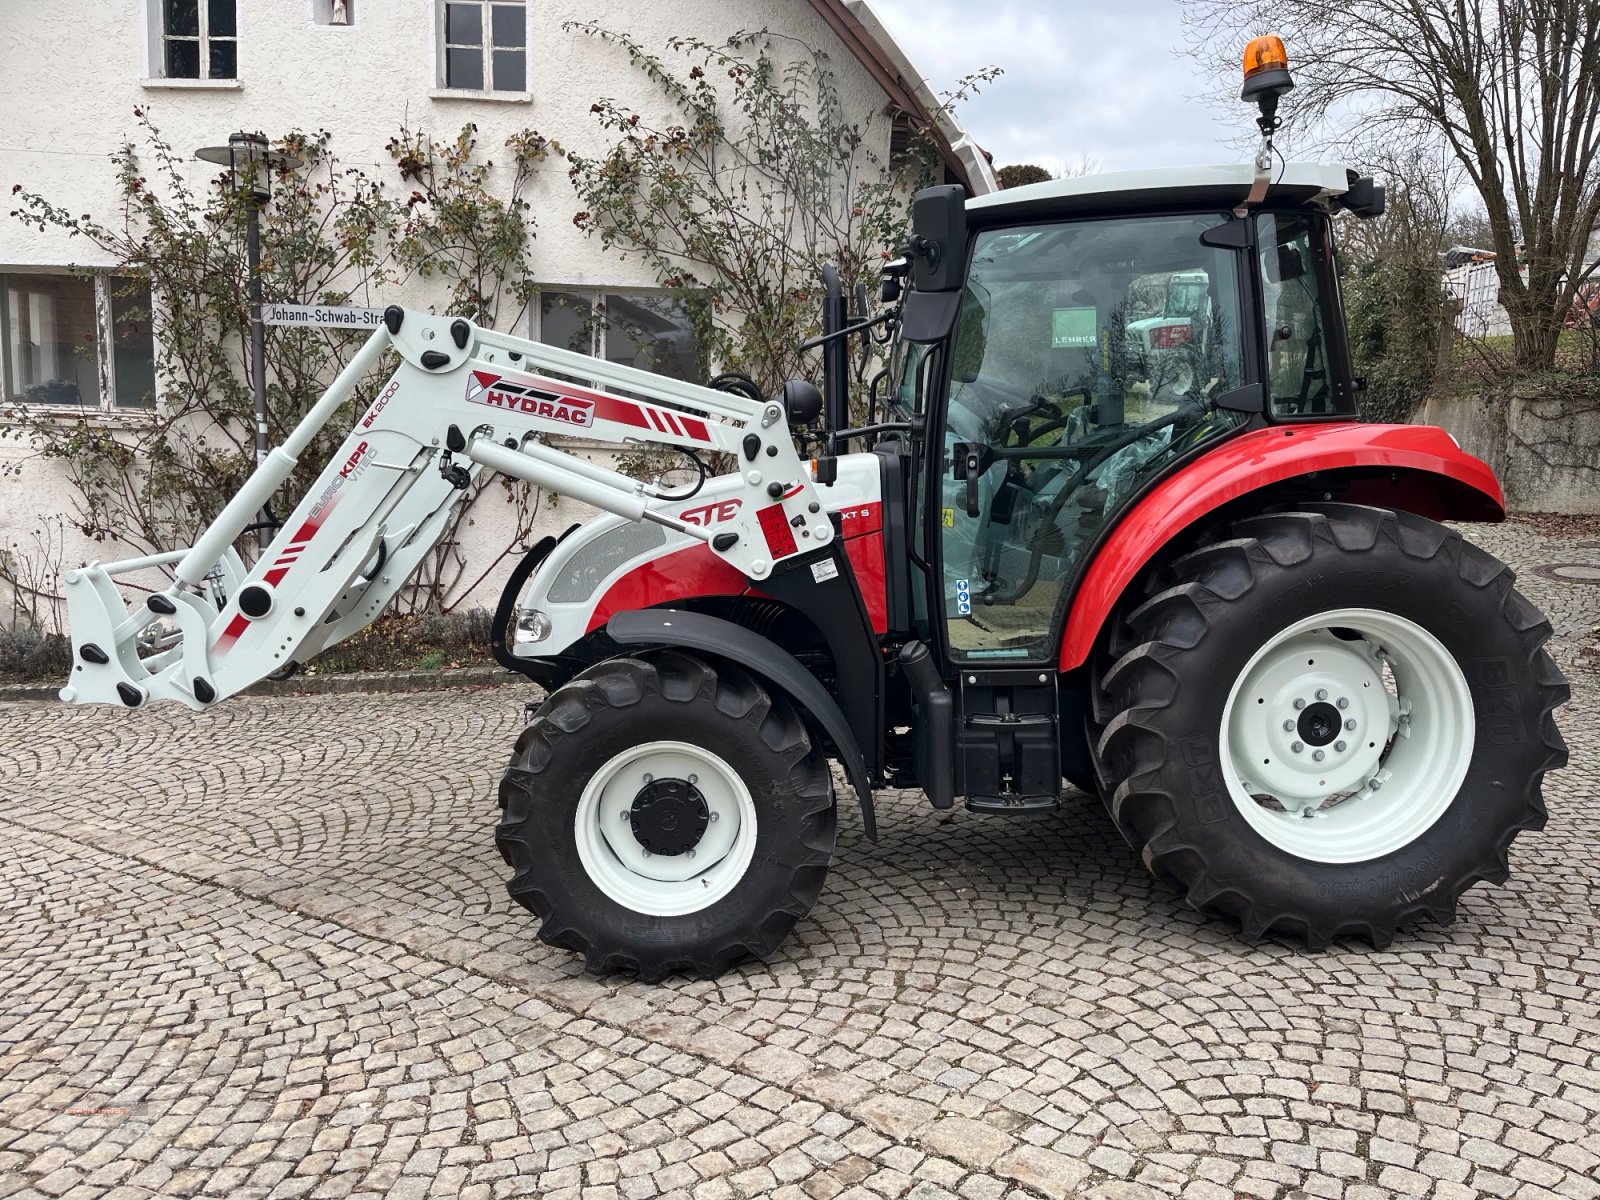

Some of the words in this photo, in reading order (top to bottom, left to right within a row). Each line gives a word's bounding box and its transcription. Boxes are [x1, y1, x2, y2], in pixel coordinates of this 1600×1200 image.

[1055, 335, 1097, 344] LEHRER
[362, 411, 378, 429] EK
[375, 381, 400, 412] 2000
[486, 390, 588, 425] HYDRAC
[308, 440, 369, 520] EUROKIPP
